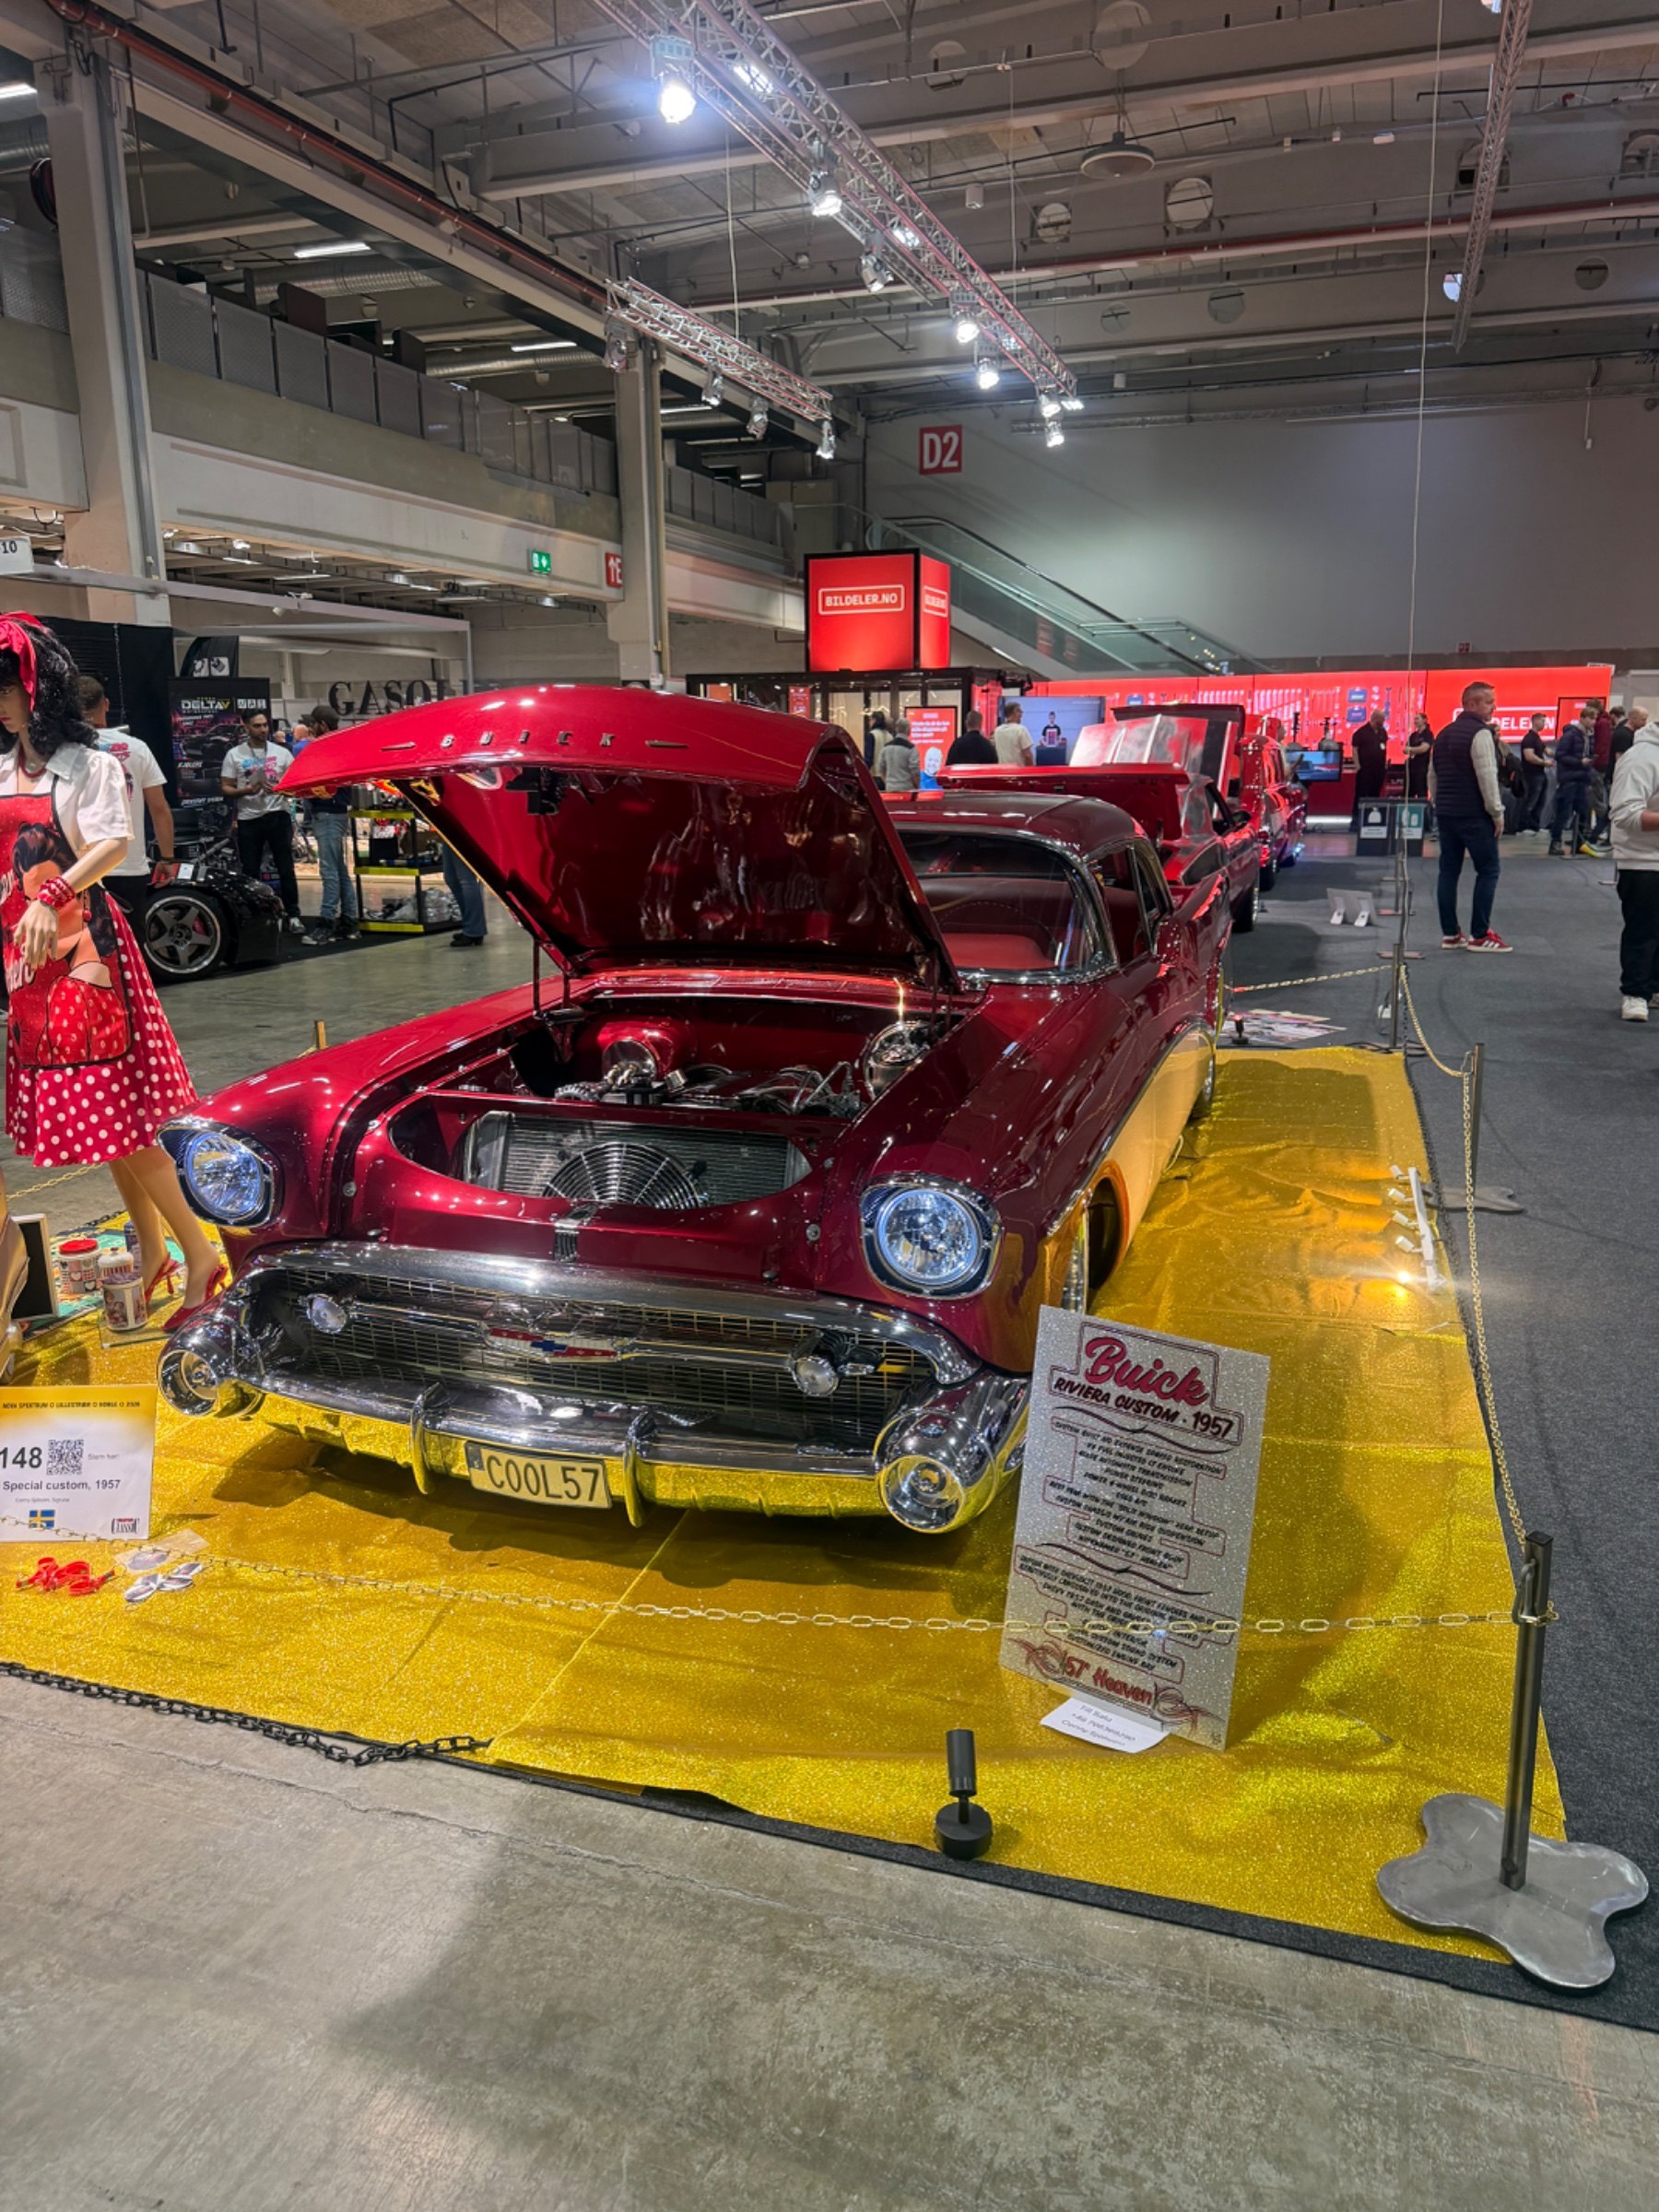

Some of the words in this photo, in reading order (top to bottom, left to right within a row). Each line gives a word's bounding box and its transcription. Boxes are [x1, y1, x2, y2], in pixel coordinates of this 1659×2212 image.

[923, 431, 959, 469] D2
[825, 593, 898, 607] BILDELER.NO
[441, 730, 614, 748] BUICK
[1085, 1336, 1209, 1406] Buick
[1053, 1377, 1111, 1404] RIVIERA
[1113, 1394, 1181, 1423] CUSTOM
[1192, 1411, 1234, 1440] 1957
[0, 1446, 42, 1469] 148
[3, 1480, 42, 1492] Special
[46, 1480, 91, 1491] custom,
[96, 1479, 121, 1489] 1957
[487, 1455, 598, 1502] COOL57
[1093, 1667, 1153, 1705] Heaven
